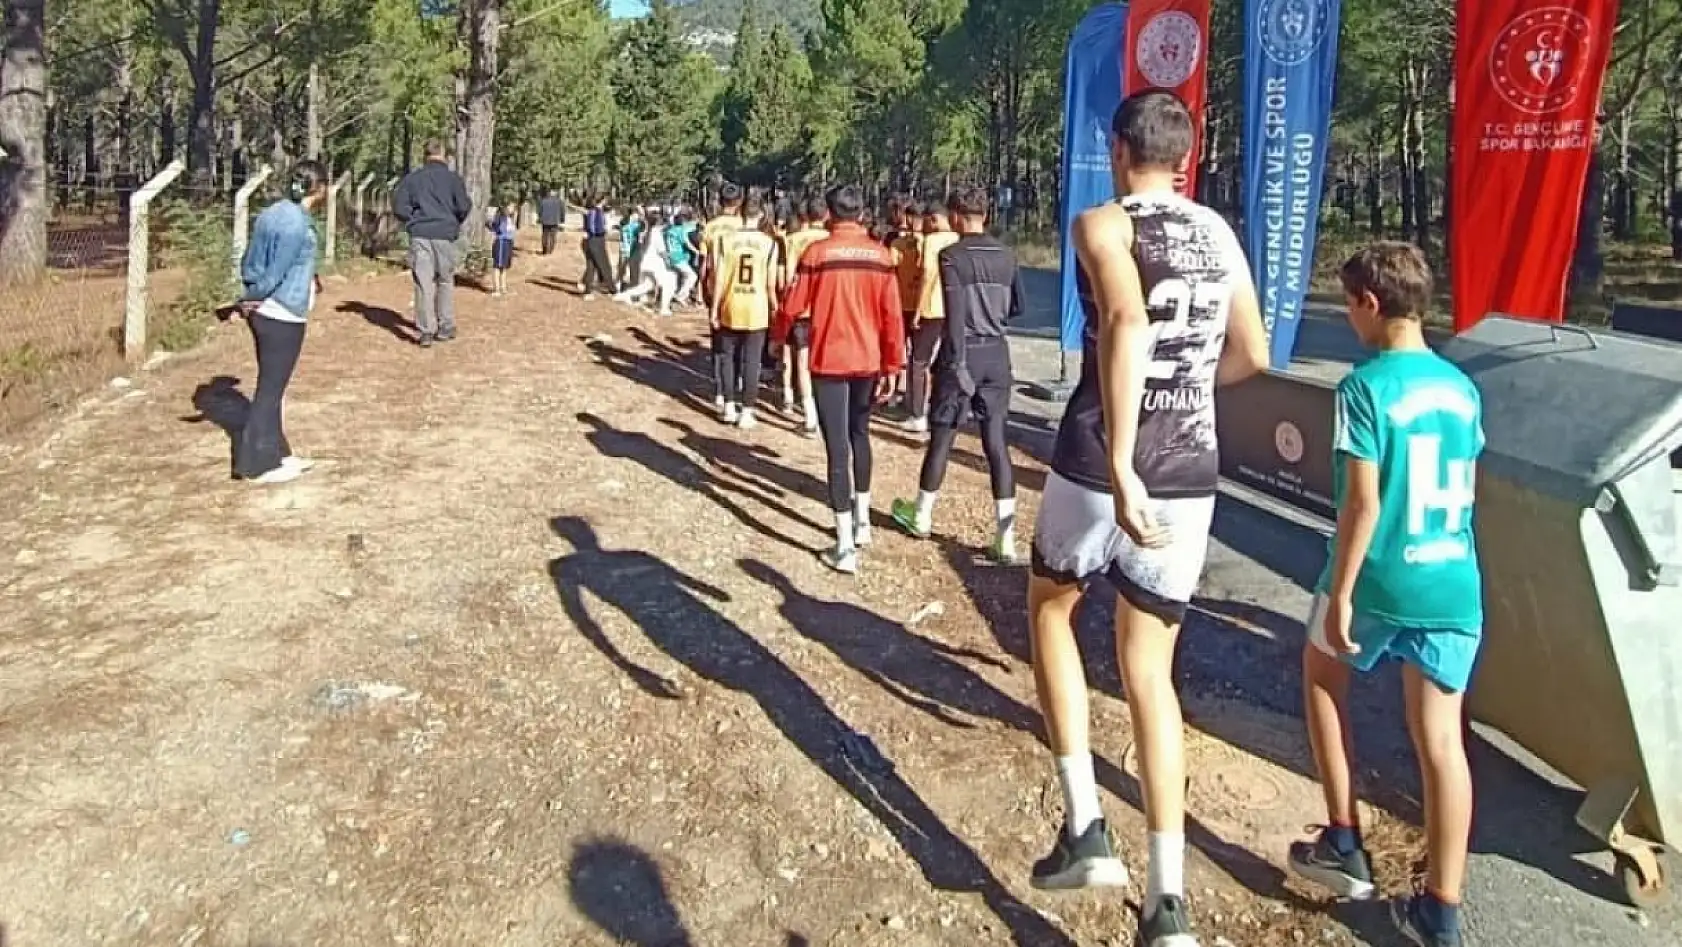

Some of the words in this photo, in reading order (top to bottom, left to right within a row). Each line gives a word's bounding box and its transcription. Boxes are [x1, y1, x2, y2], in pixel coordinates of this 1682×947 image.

[1266, 77, 1286, 139] SPOR
[1267, 145, 1285, 175] VE
[739, 253, 753, 285] 6
